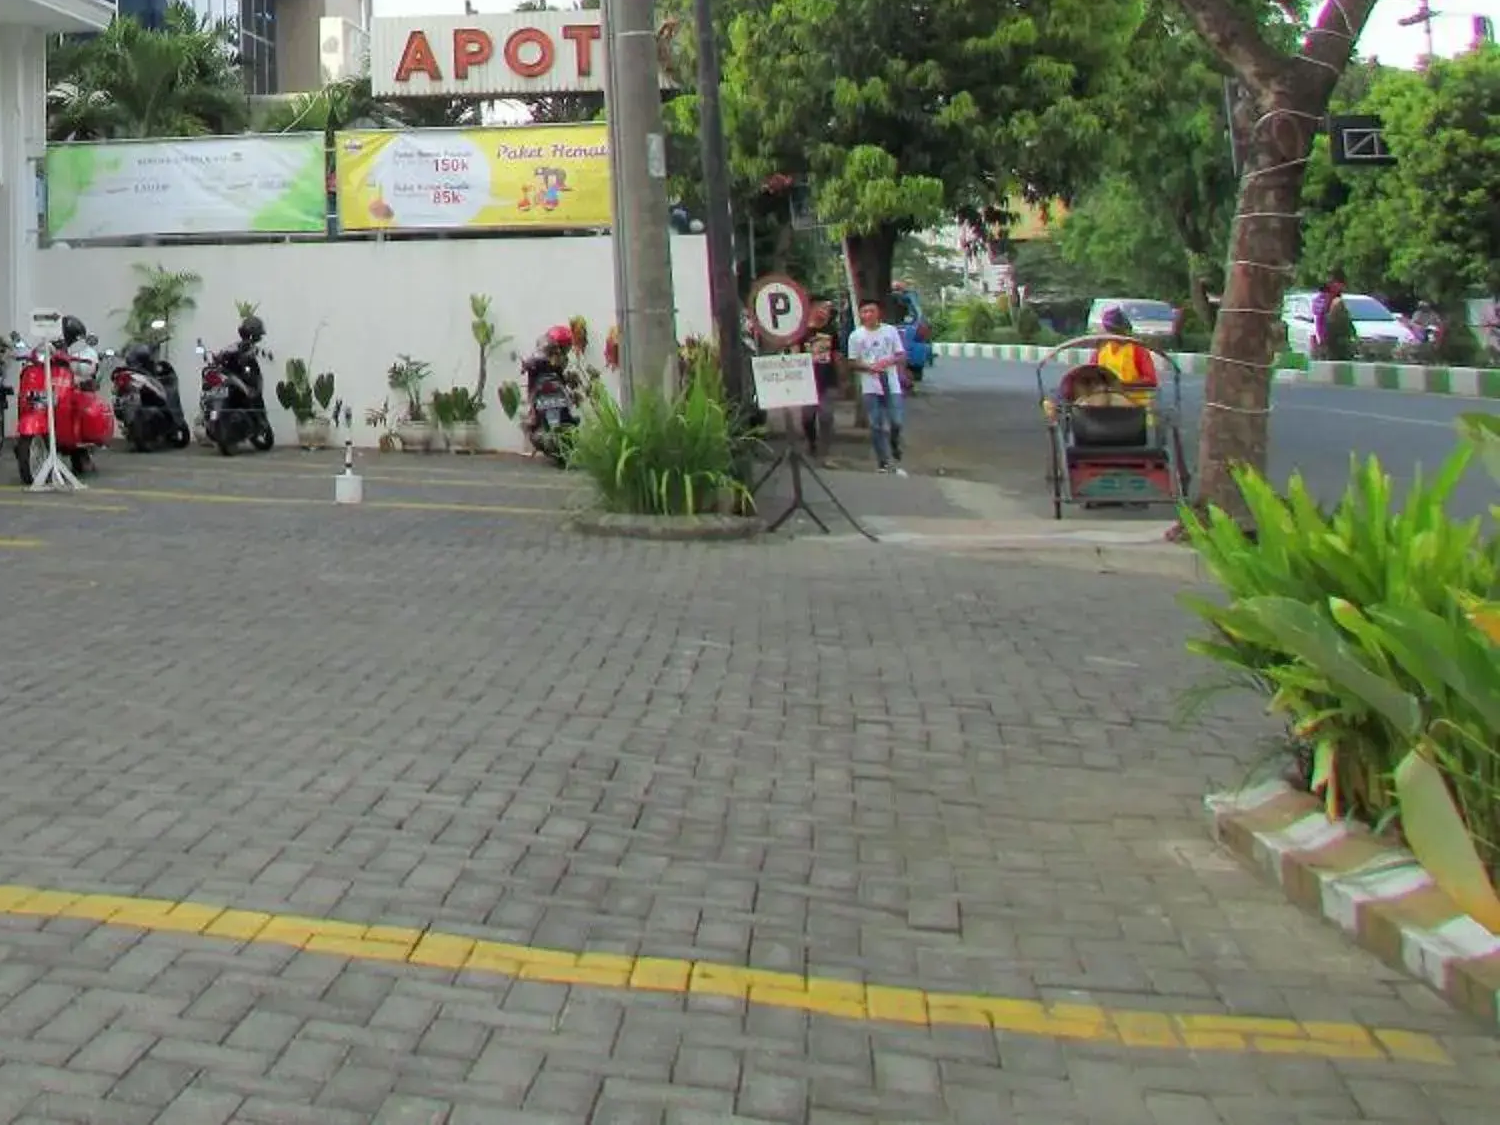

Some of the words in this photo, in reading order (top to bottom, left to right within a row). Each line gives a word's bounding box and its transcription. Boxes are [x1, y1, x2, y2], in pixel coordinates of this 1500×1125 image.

[395, 22, 680, 80] APOT
[497, 144, 543, 160] Paket
[768, 292, 791, 330] P
